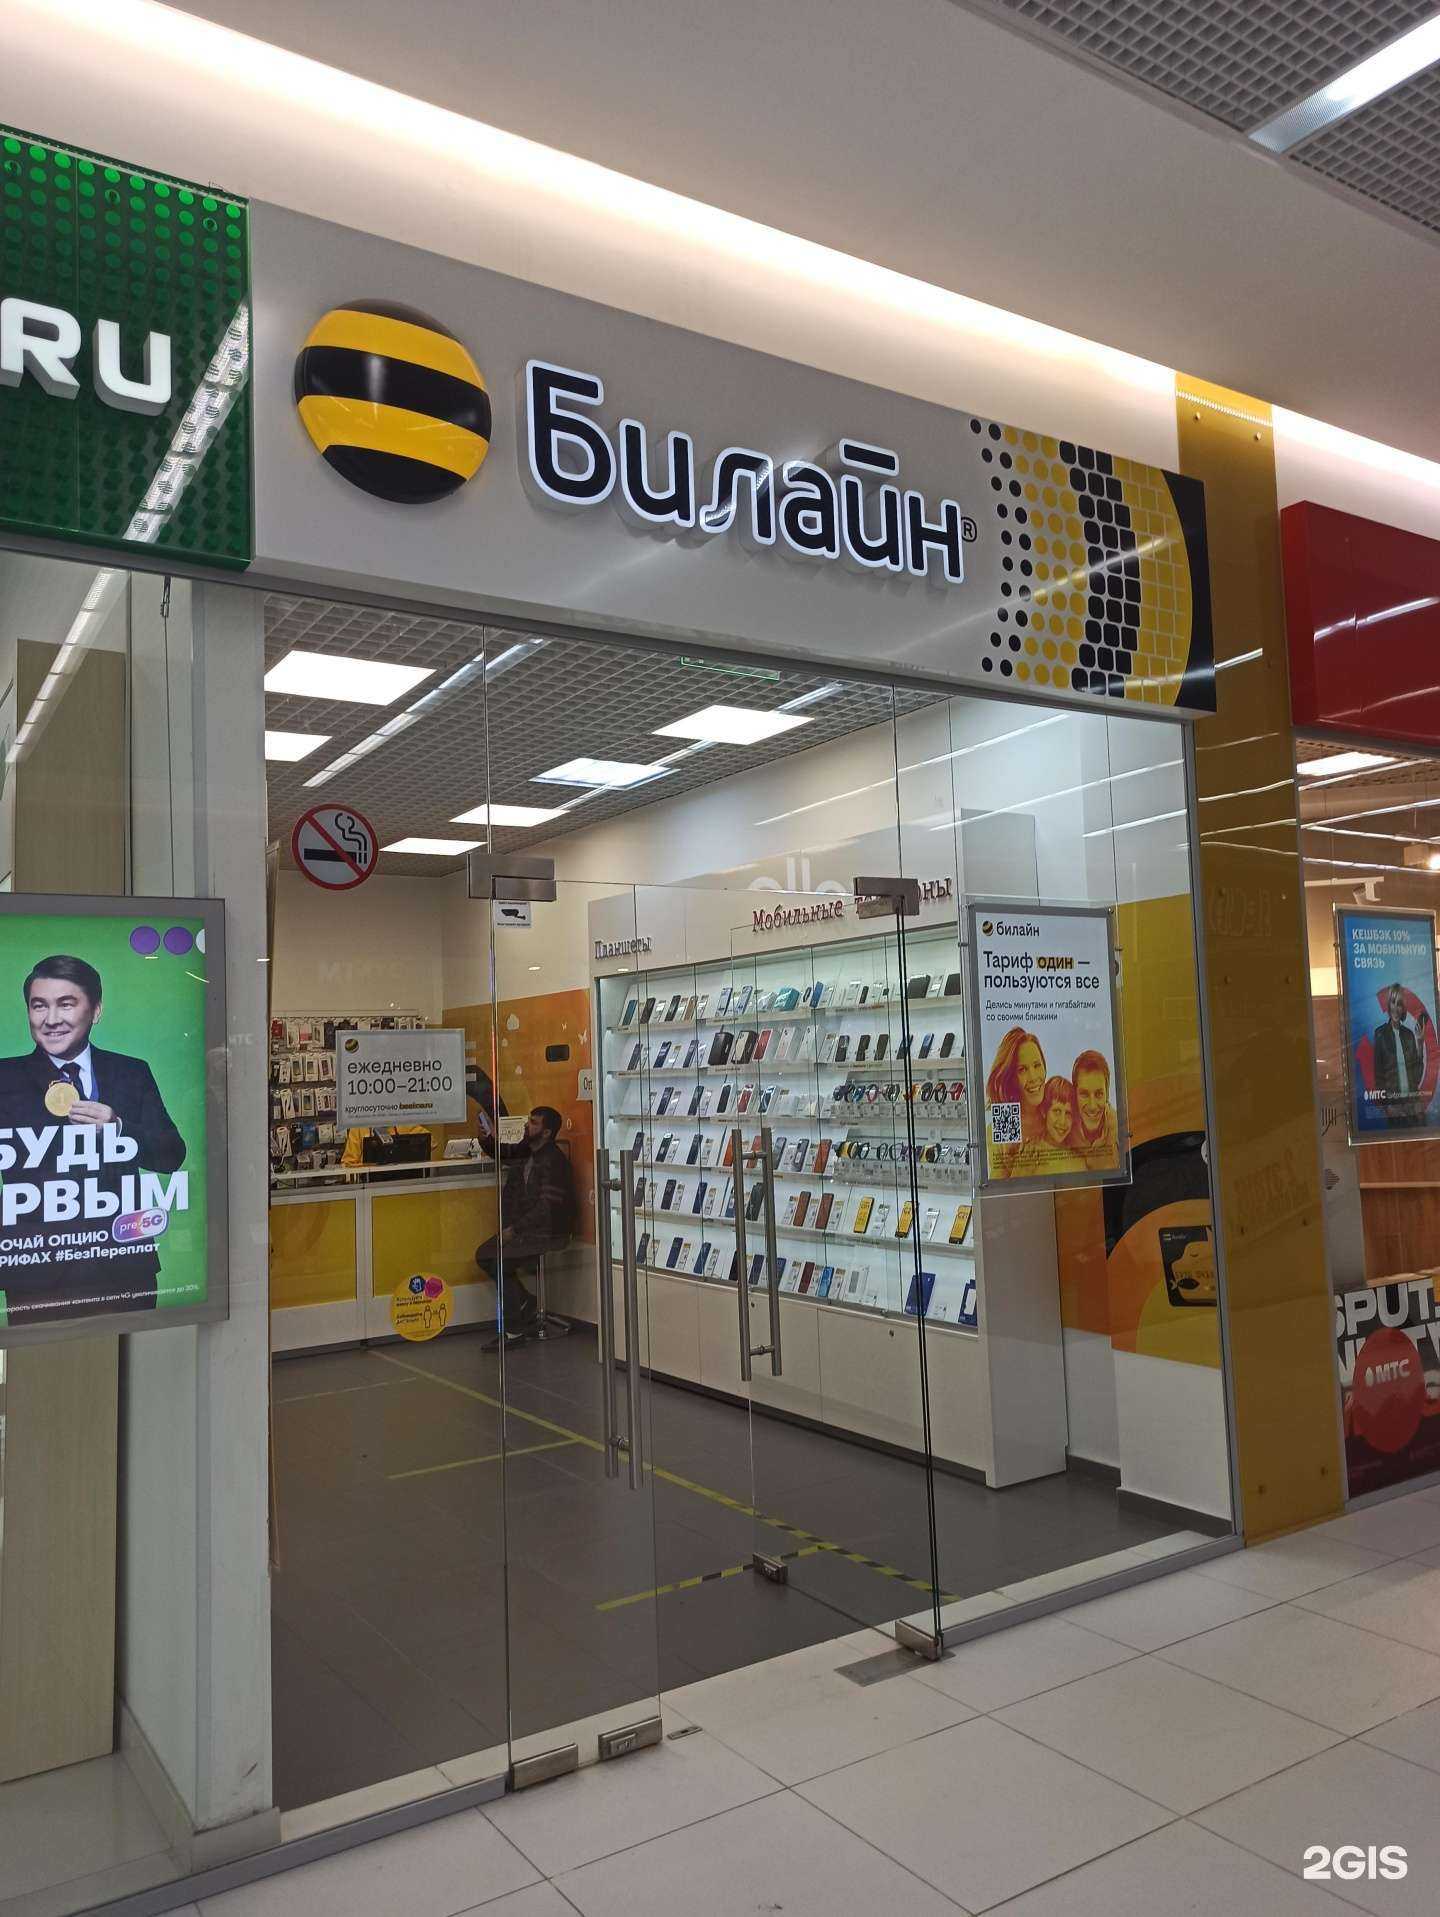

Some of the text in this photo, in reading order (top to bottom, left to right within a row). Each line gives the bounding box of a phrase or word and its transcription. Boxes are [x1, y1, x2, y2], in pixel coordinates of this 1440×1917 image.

[0, 297, 171, 412] RU
[752, 899, 843, 932] Мобильные
[996, 921, 1040, 937] билайн
[1352, 928, 1410, 942] КЕШБЭК 10%
[594, 936, 652, 960] Планшеты
[1353, 942, 1426, 956] ЗА МОБИЛЬНУЮ
[983, 951, 1033, 973] Тариф
[1037, 956, 1074, 972] один
[1354, 957, 1385, 968] СВЯЗЬ
[984, 975, 1100, 993] пользуются все
[986, 1000, 1012, 1010] Делись
[1013, 1002, 1048, 1010] минутами
[1055, 1000, 1096, 1009] гигабайтами
[986, 1011, 1058, 1021] со своими близкими
[347, 1060, 442, 1076] ежедневно
[345, 1102, 398, 1113] круглосуточно
[48, 1229, 109, 1247] ОПЦИЮ
[0, 1243, 161, 1268] РИФАХ #БезПереплат
[1375, 1358, 1409, 1384] МТС
